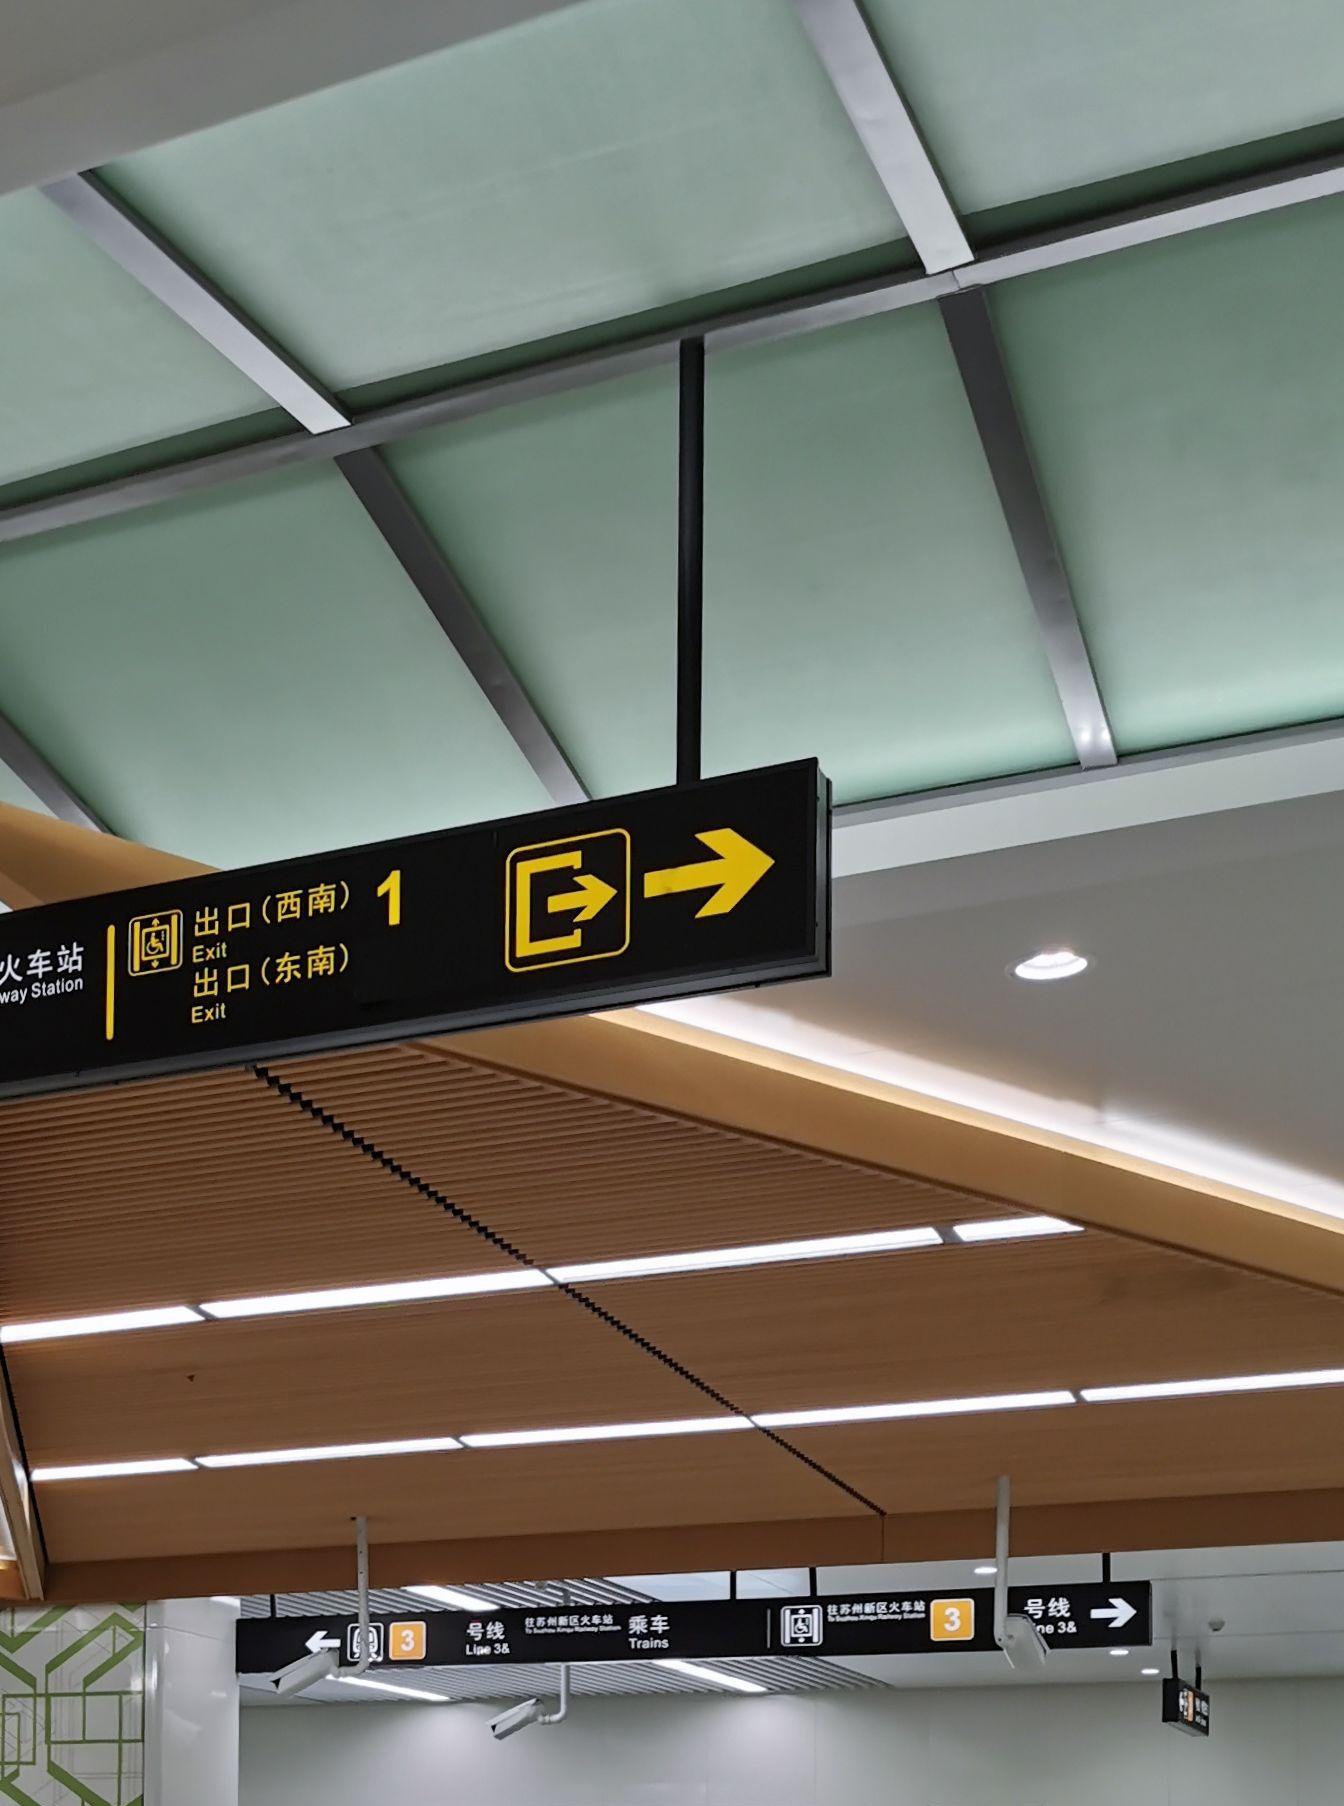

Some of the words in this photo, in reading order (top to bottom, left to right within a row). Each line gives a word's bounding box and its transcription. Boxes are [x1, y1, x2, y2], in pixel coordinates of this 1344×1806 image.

[376, 869, 401, 927] 1
[194, 881, 350, 938] 出口（西南）
[192, 941, 228, 964] Exit
[193, 943, 349, 999] 出口（东南）
[31, 976, 84, 999] Station
[191, 1003, 226, 1024] Exit
[827, 1600, 926, 1616] 往苏州新区火车站
[1024, 1597, 1071, 1619] 号线
[525, 1614, 613, 1628] 往苏州新区火车站
[628, 1615, 670, 1635] 乘车
[944, 1607, 961, 1632] 3
[401, 1630, 414, 1651] 3
[466, 1621, 505, 1641] 号线
[466, 1644, 491, 1655] Line
[629, 1638, 669, 1649] Trains
